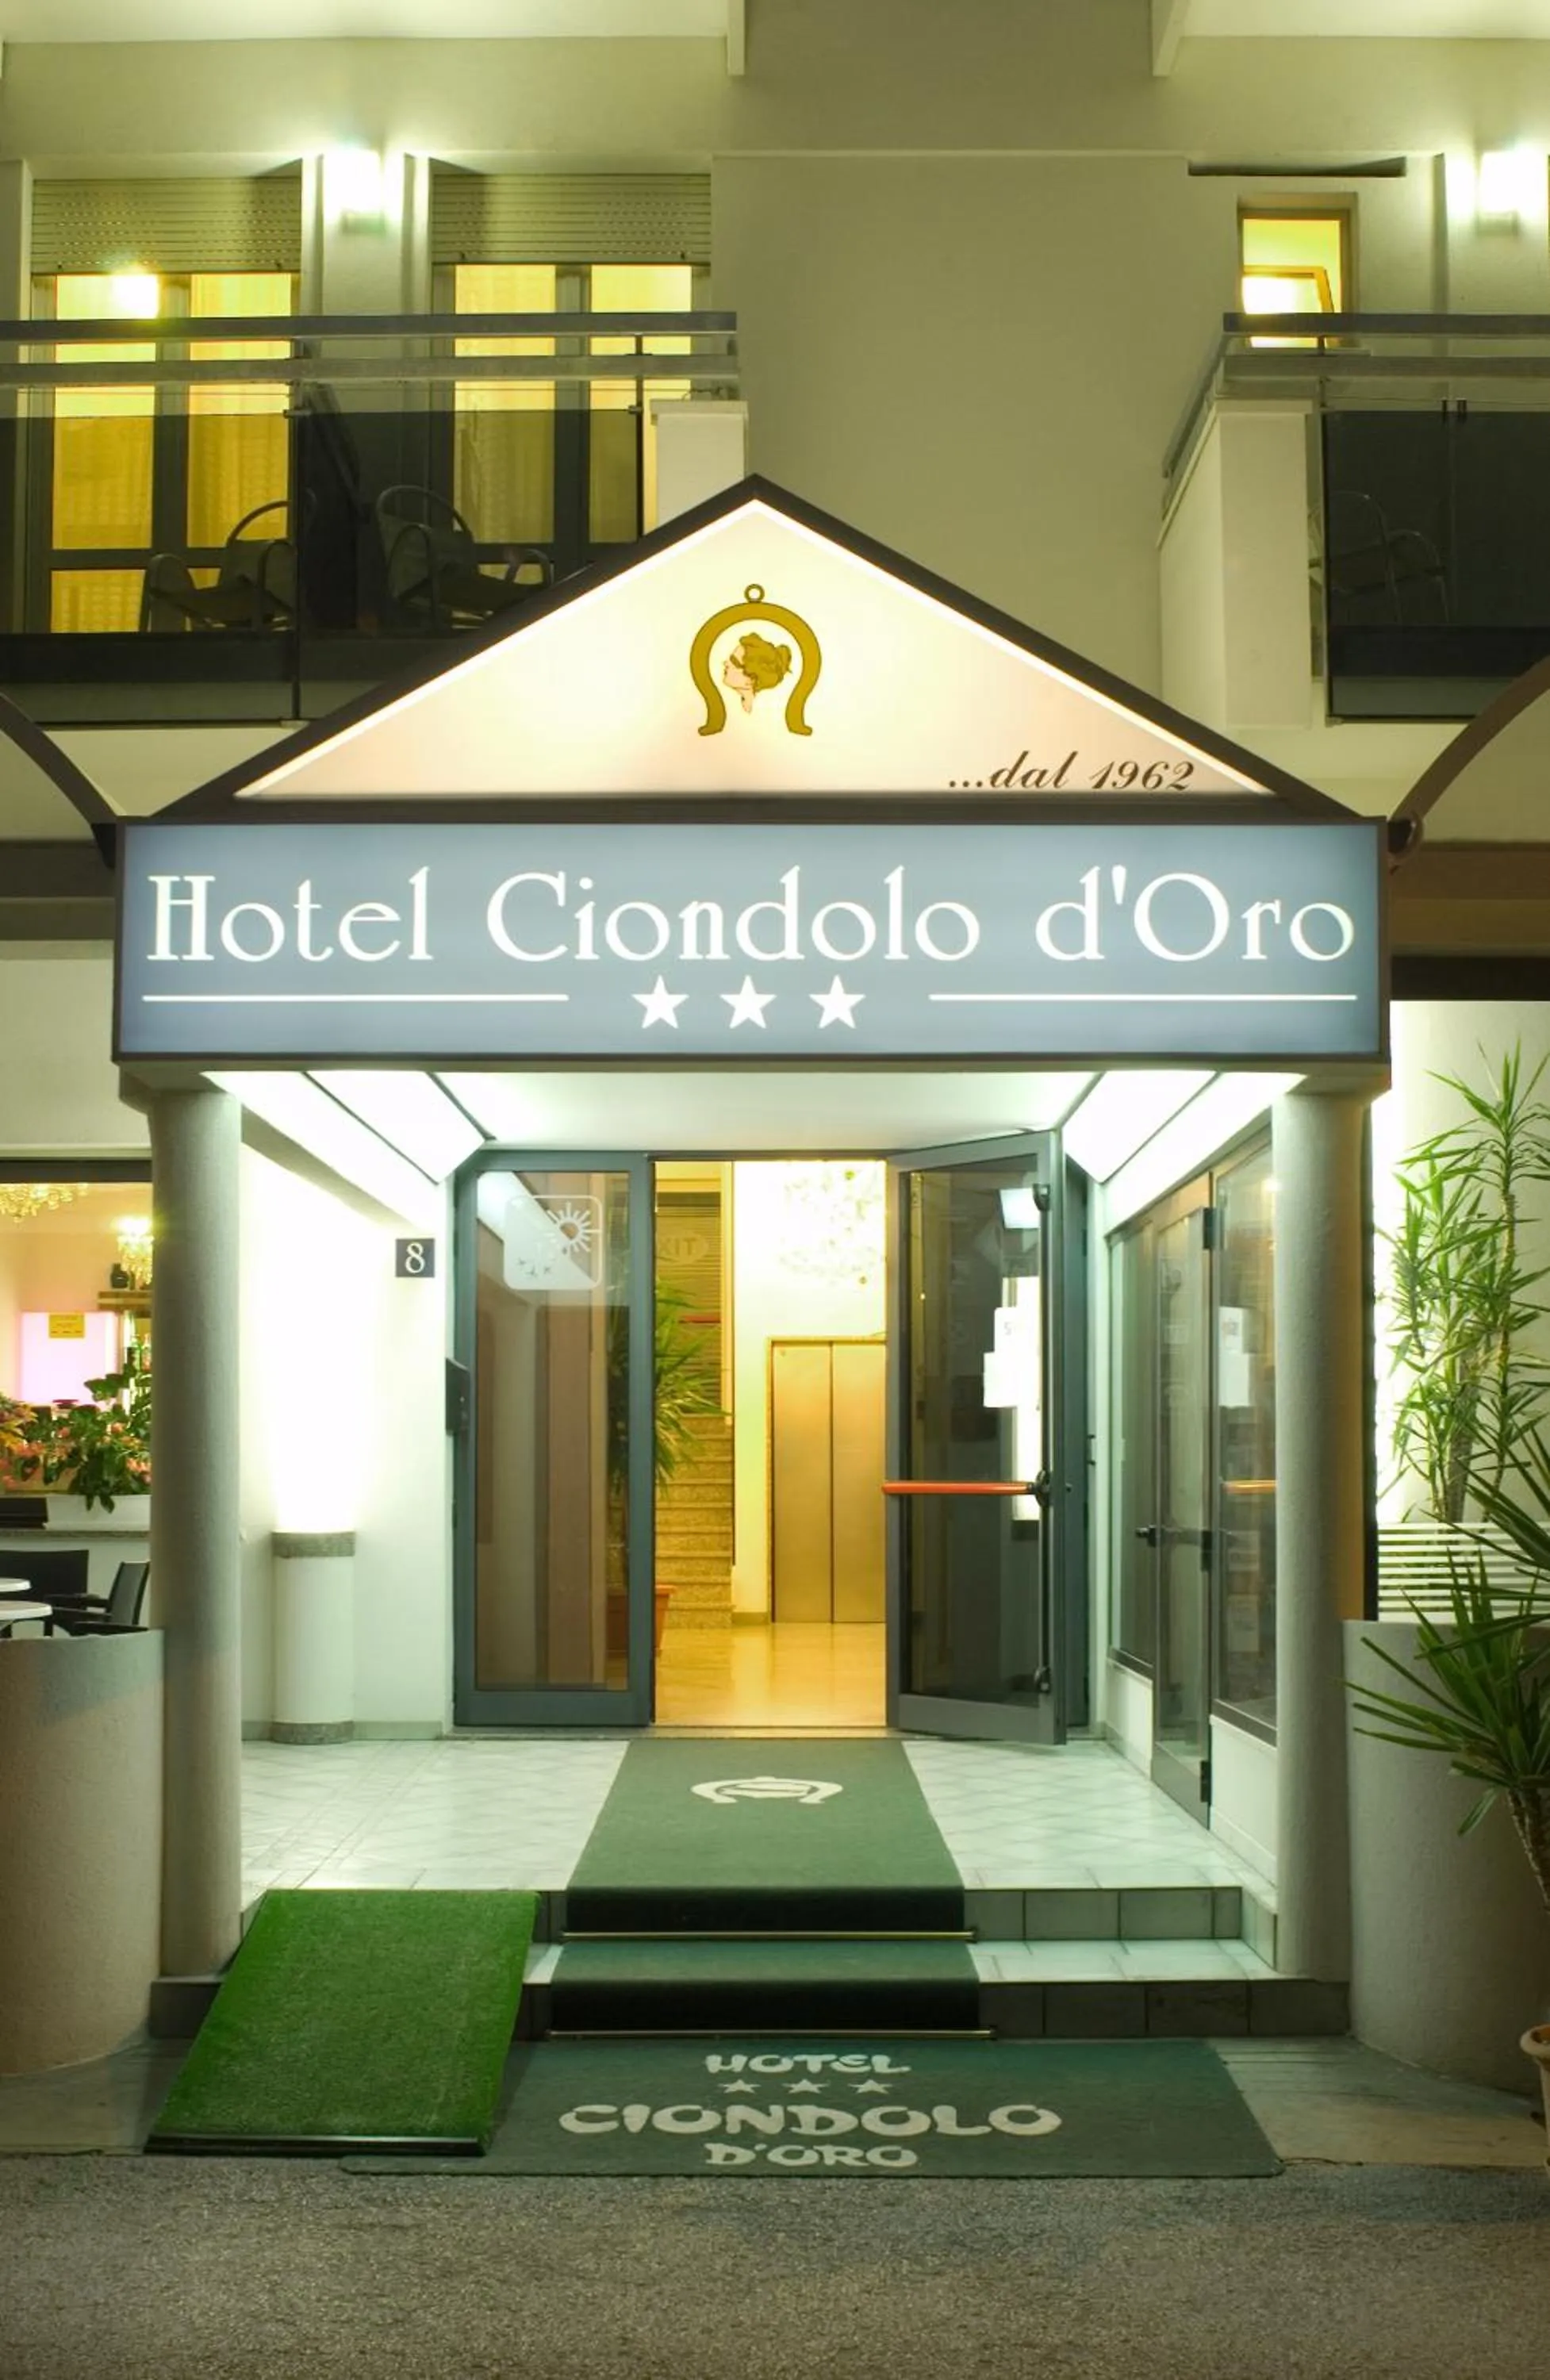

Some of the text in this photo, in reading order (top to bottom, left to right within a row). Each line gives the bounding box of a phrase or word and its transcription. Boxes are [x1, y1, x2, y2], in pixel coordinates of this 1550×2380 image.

[949, 750, 1195, 791] ...dal 1962
[146, 865, 1354, 962] Hotel Ciondolo d'Oro
[405, 1242, 425, 1273] 8
[658, 1237, 696, 1256] XIT
[704, 2053, 911, 2075] HOTEL
[558, 2104, 1063, 2136] CIONDOLO
[704, 2142, 918, 2167] D'ORO
